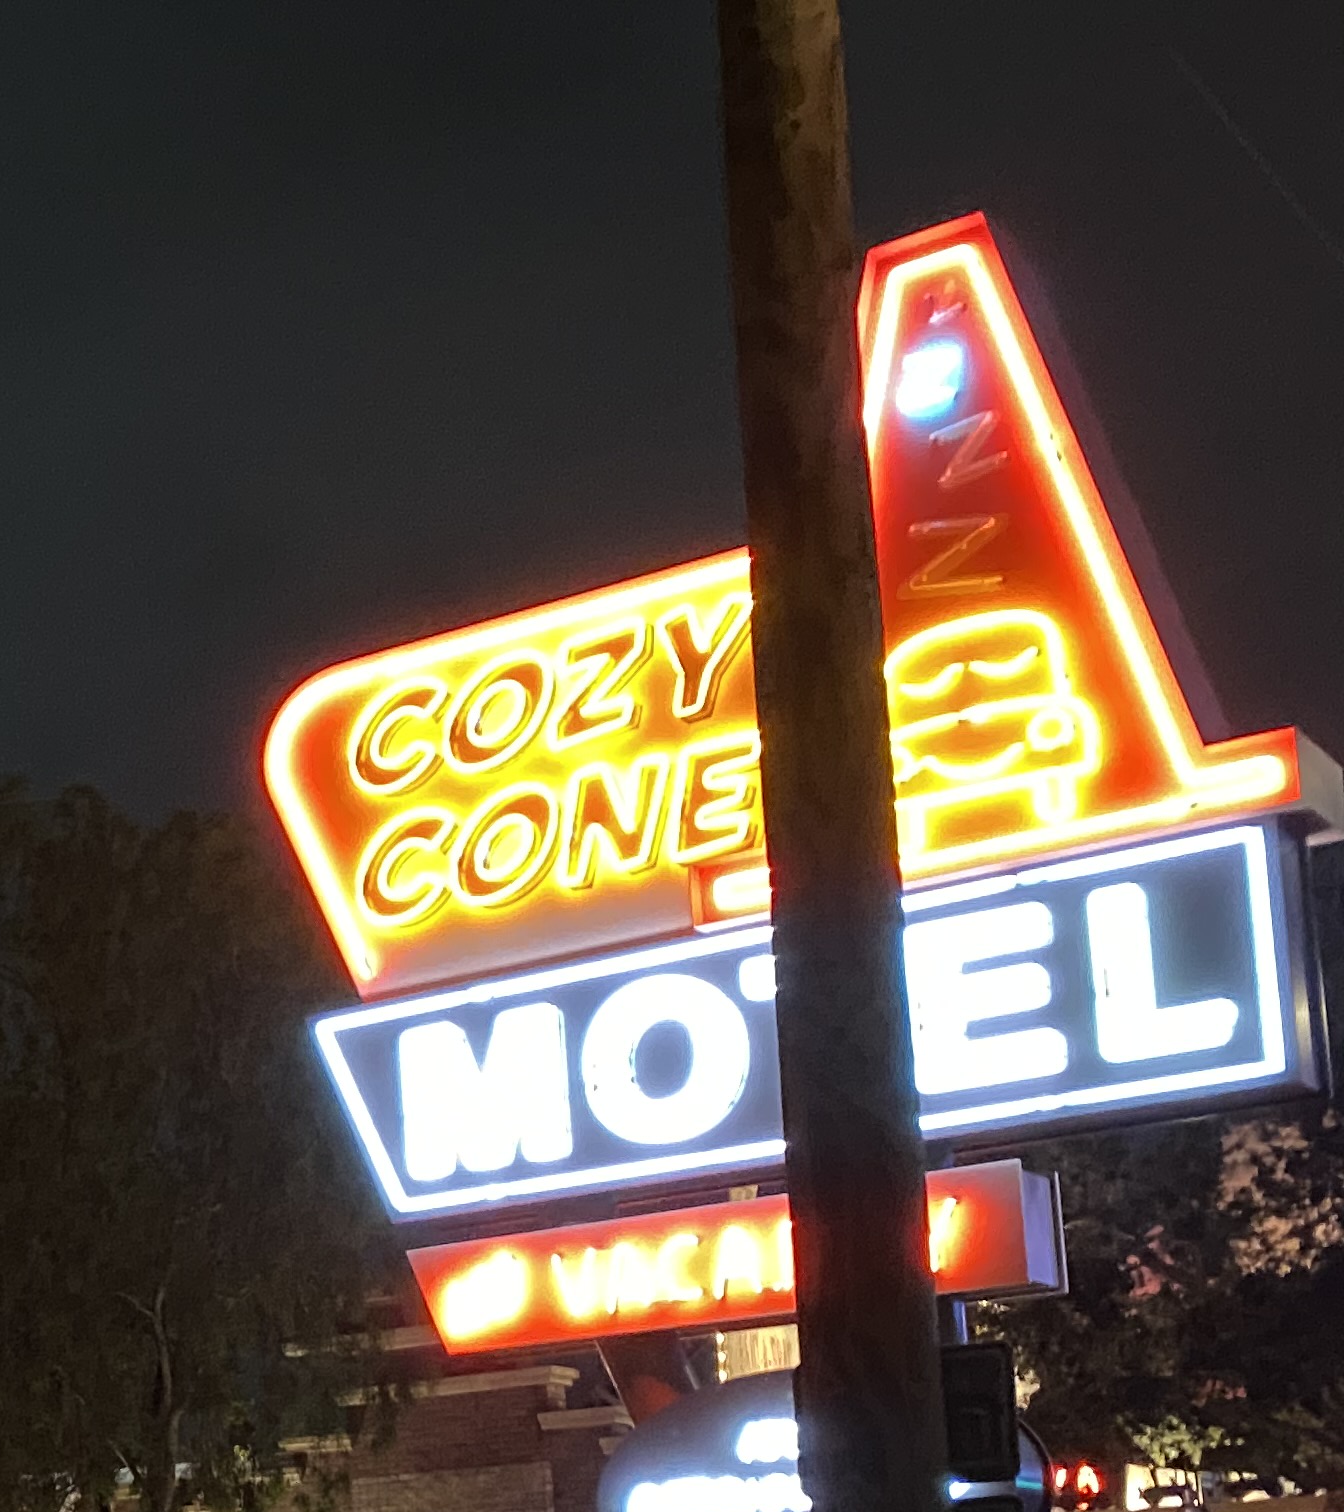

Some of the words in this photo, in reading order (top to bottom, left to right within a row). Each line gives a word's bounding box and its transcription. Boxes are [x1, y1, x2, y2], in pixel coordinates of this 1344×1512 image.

[348, 591, 753, 797] COZY
[355, 728, 762, 929] CONE
[398, 880, 1241, 1183] MOEL
[550, 1195, 958, 1318] VACAY
